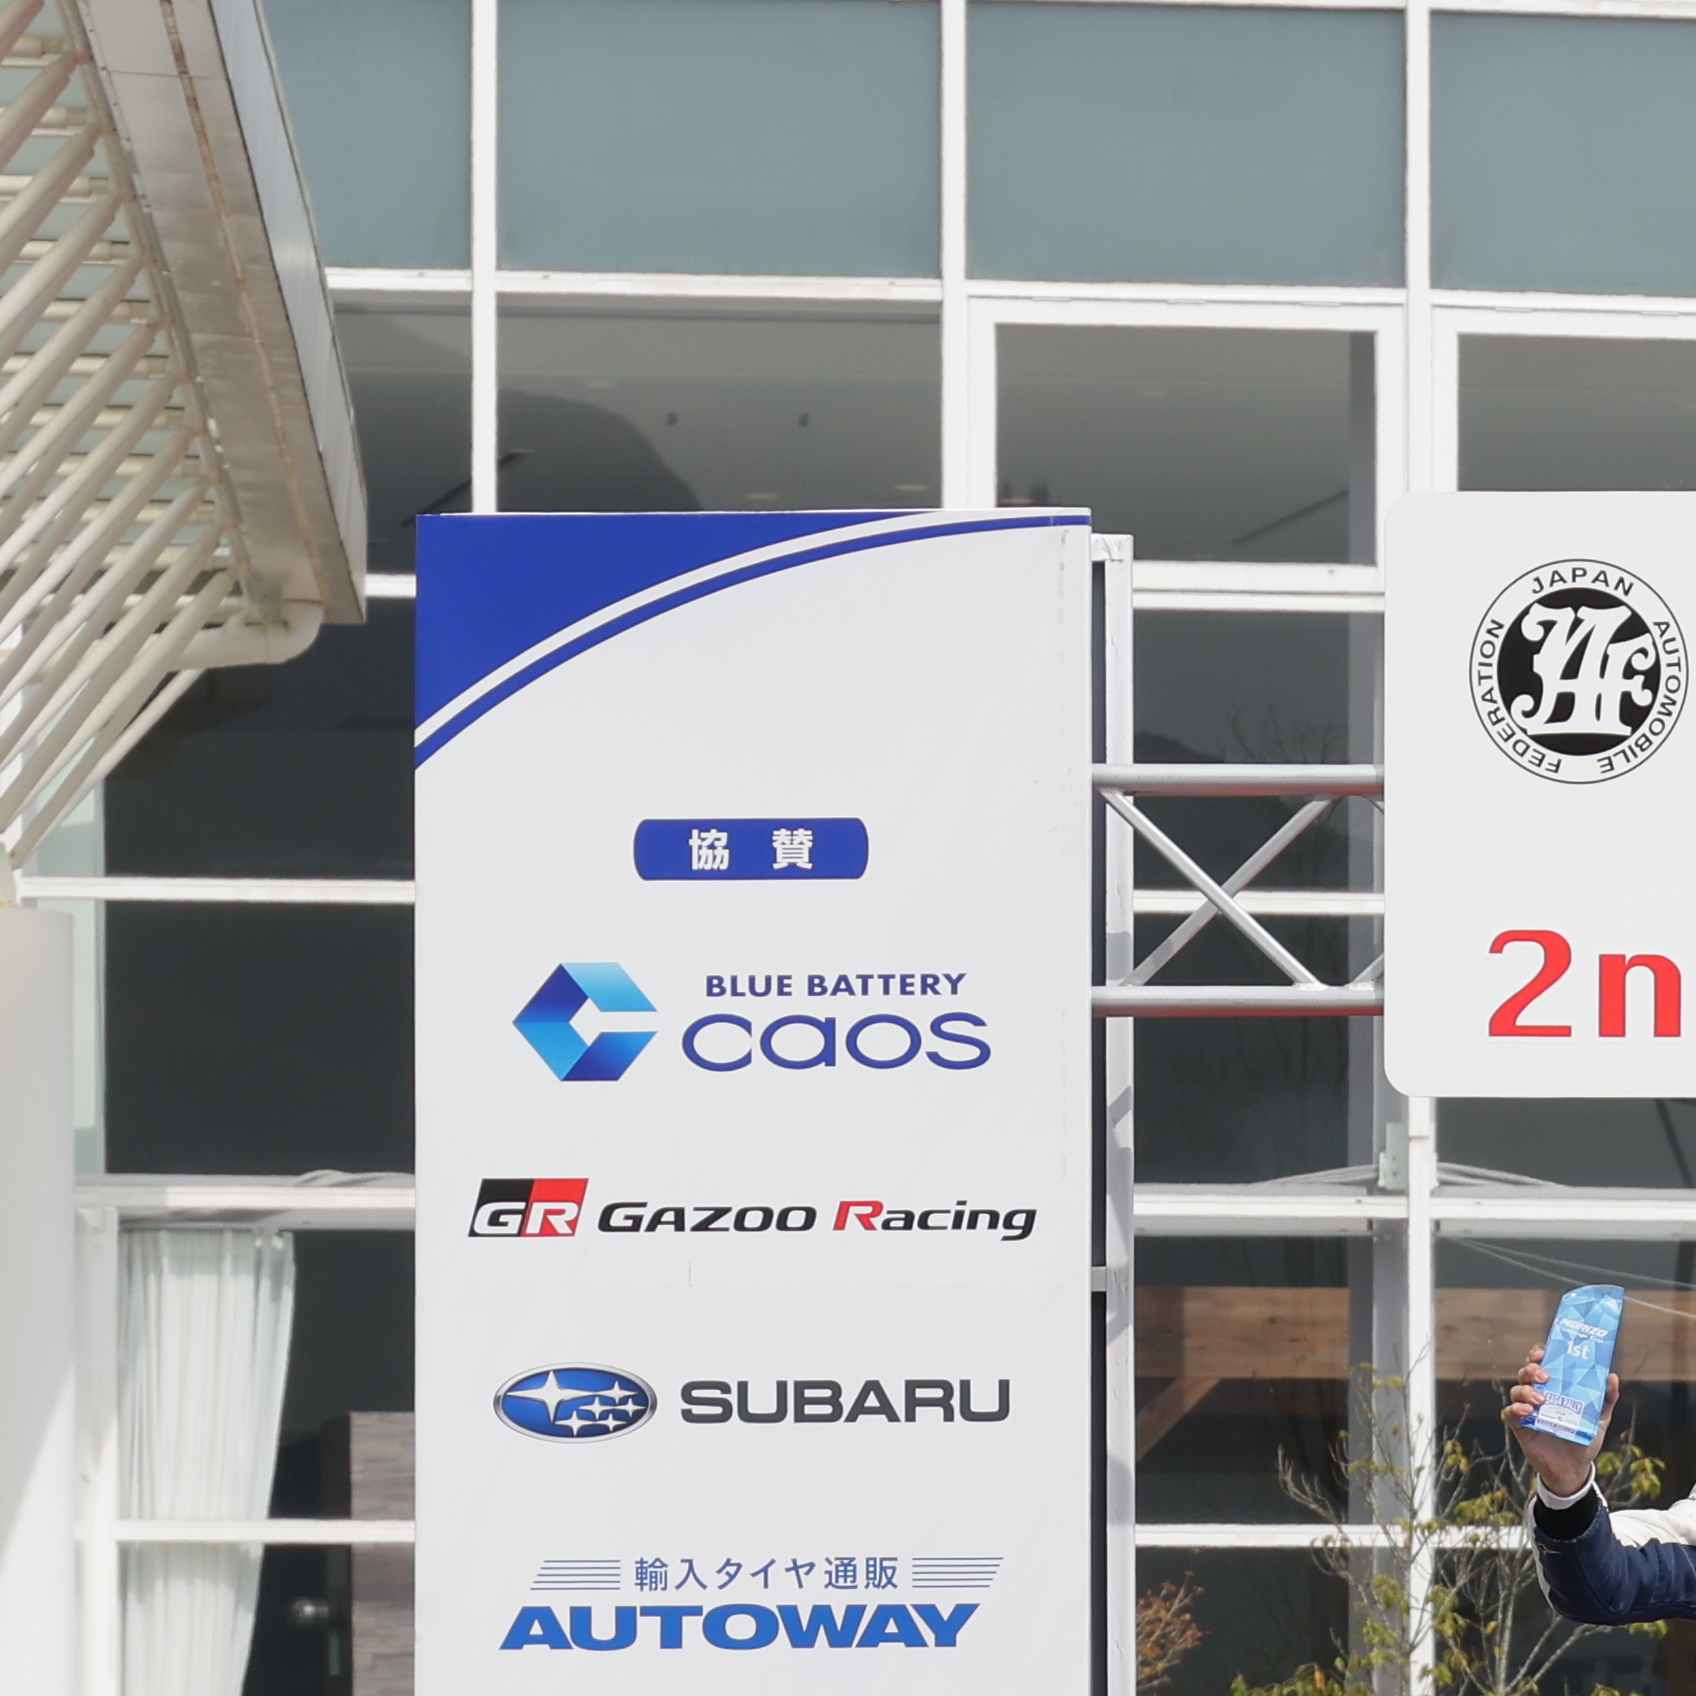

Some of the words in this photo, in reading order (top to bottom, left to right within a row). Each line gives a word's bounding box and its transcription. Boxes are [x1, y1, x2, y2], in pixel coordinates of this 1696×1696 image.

[1531, 567, 1634, 597] JAPAN
[688, 828, 814, 870] 協賛
[705, 975, 793, 998] BLUE
[808, 973, 967, 997] BATTERY
[682, 1012, 991, 1072] caos
[833, 1200, 1037, 1242] Racing
[1566, 1341, 1590, 1360] 1st
[680, 1379, 1011, 1423] SUBARU
[634, 1556, 899, 1591] 輸入タイヤ通販
[499, 1603, 980, 1651] AUTOWAY
